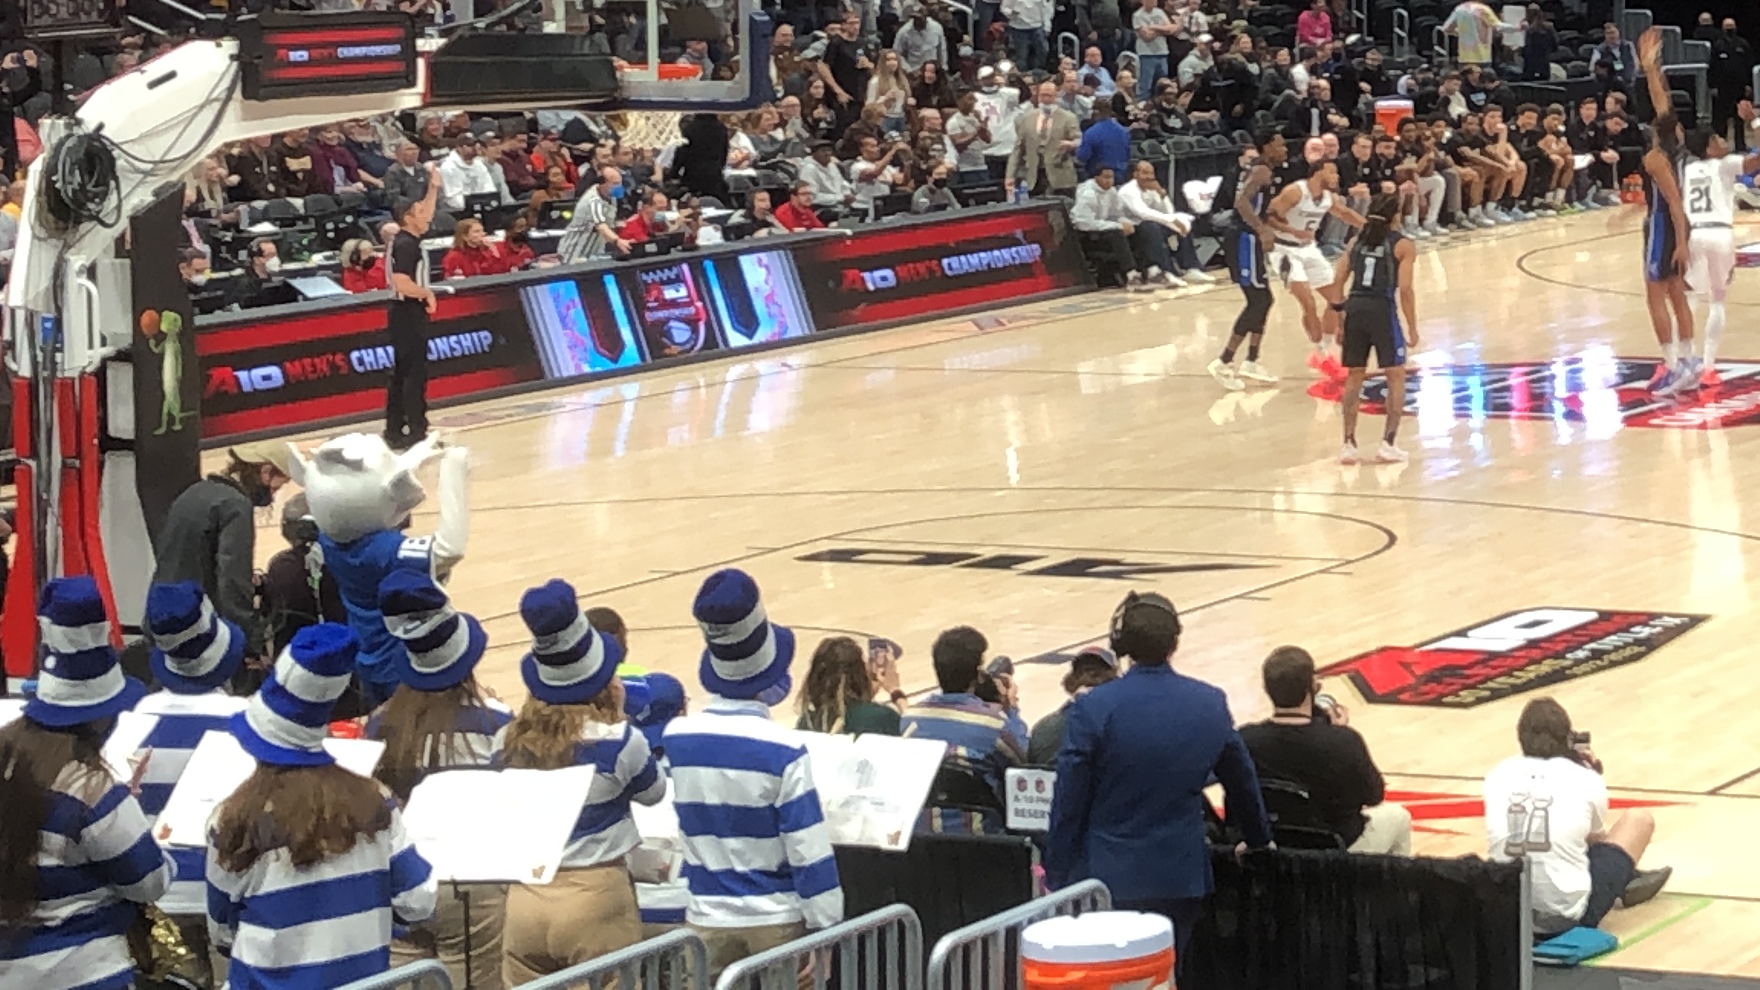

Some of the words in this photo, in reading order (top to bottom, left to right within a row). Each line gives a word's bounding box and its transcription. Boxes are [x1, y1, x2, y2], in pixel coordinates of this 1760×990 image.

[1690, 185, 1713, 214] 21
[941, 243, 1042, 277] CHAMPIONSHIP
[1362, 256, 1377, 287] 1
[204, 364, 285, 399] A10
[350, 329, 493, 374] CHAONSHIP
